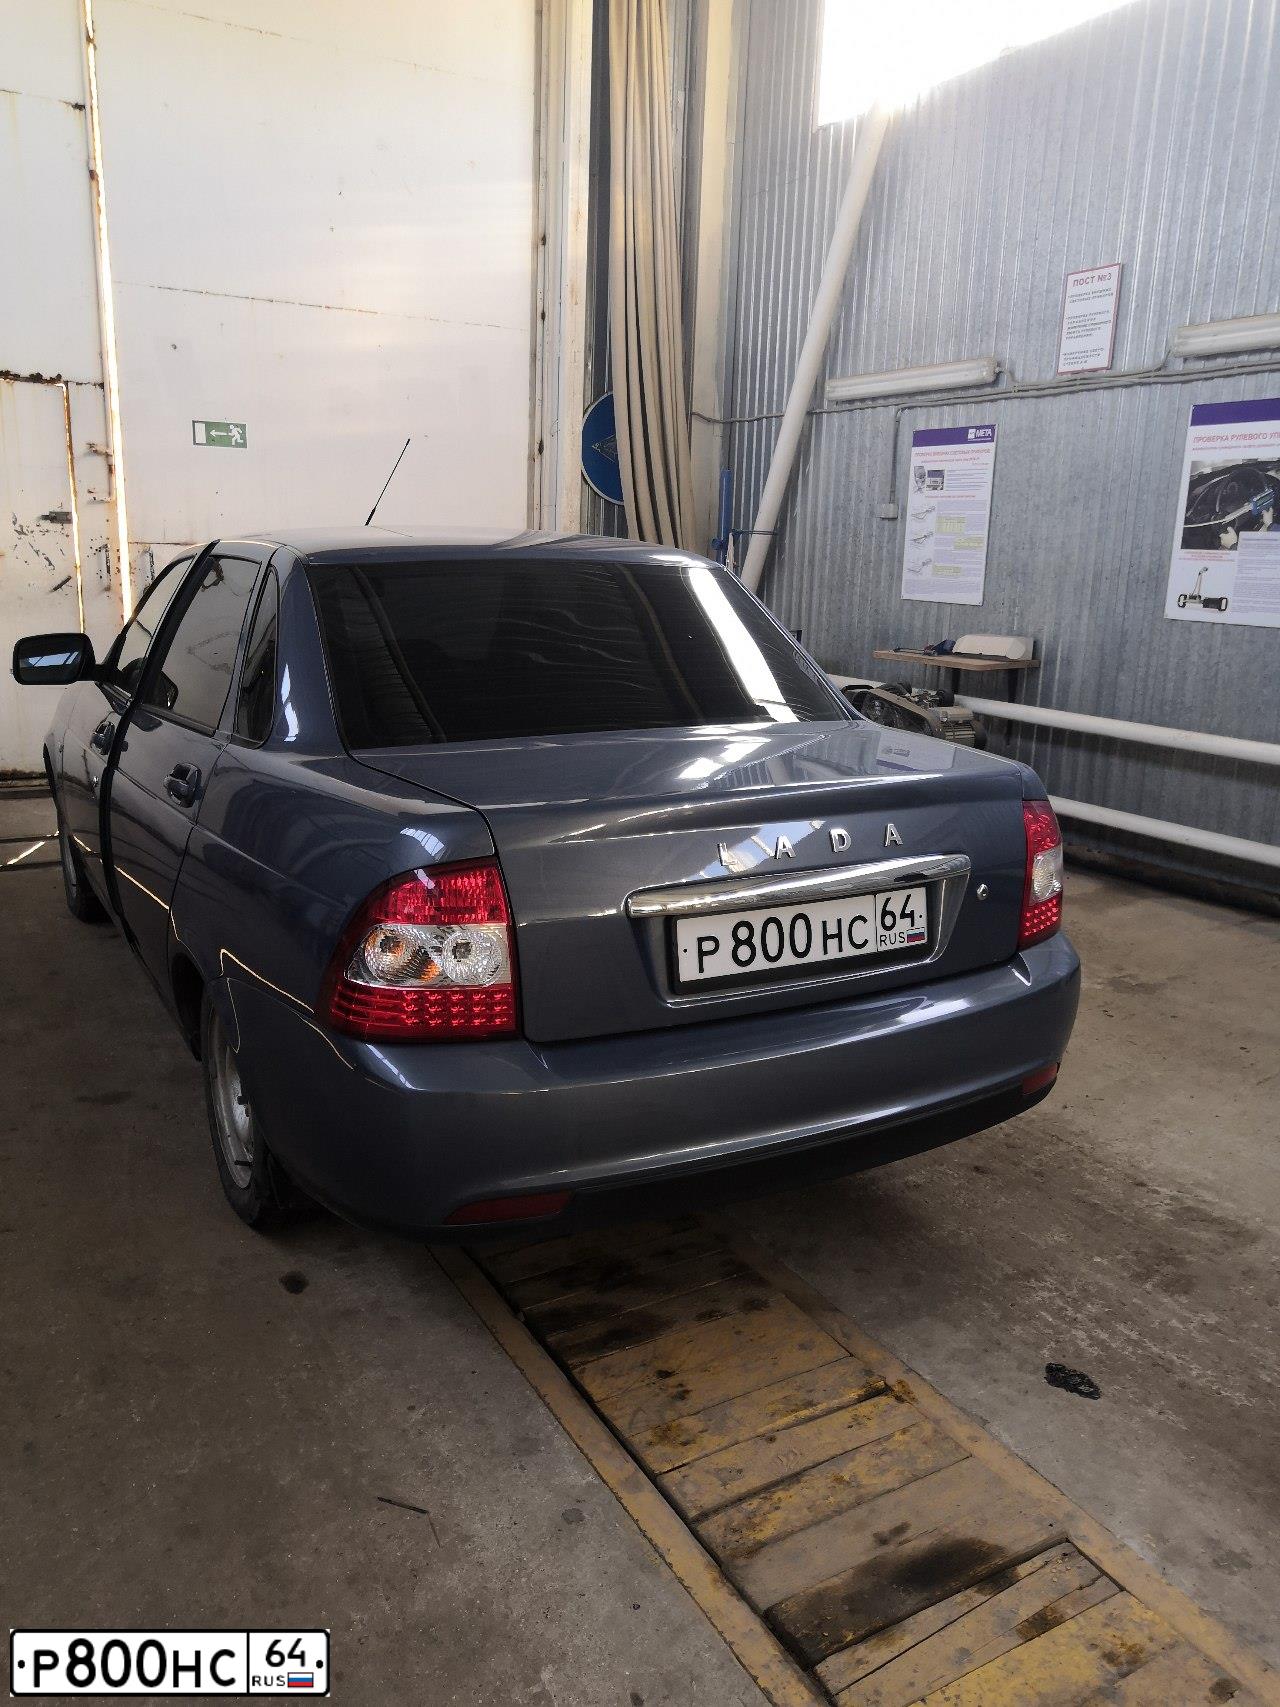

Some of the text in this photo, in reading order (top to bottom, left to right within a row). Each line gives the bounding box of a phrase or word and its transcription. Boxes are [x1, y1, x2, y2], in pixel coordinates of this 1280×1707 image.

[1073, 276, 1096, 288] ПОСТ
[1193, 434, 1229, 444] ПРОВЕРКА
[717, 823, 904, 867] LADA
[697, 893, 915, 974] Р800НС 64
[879, 931, 906, 947] RUS
